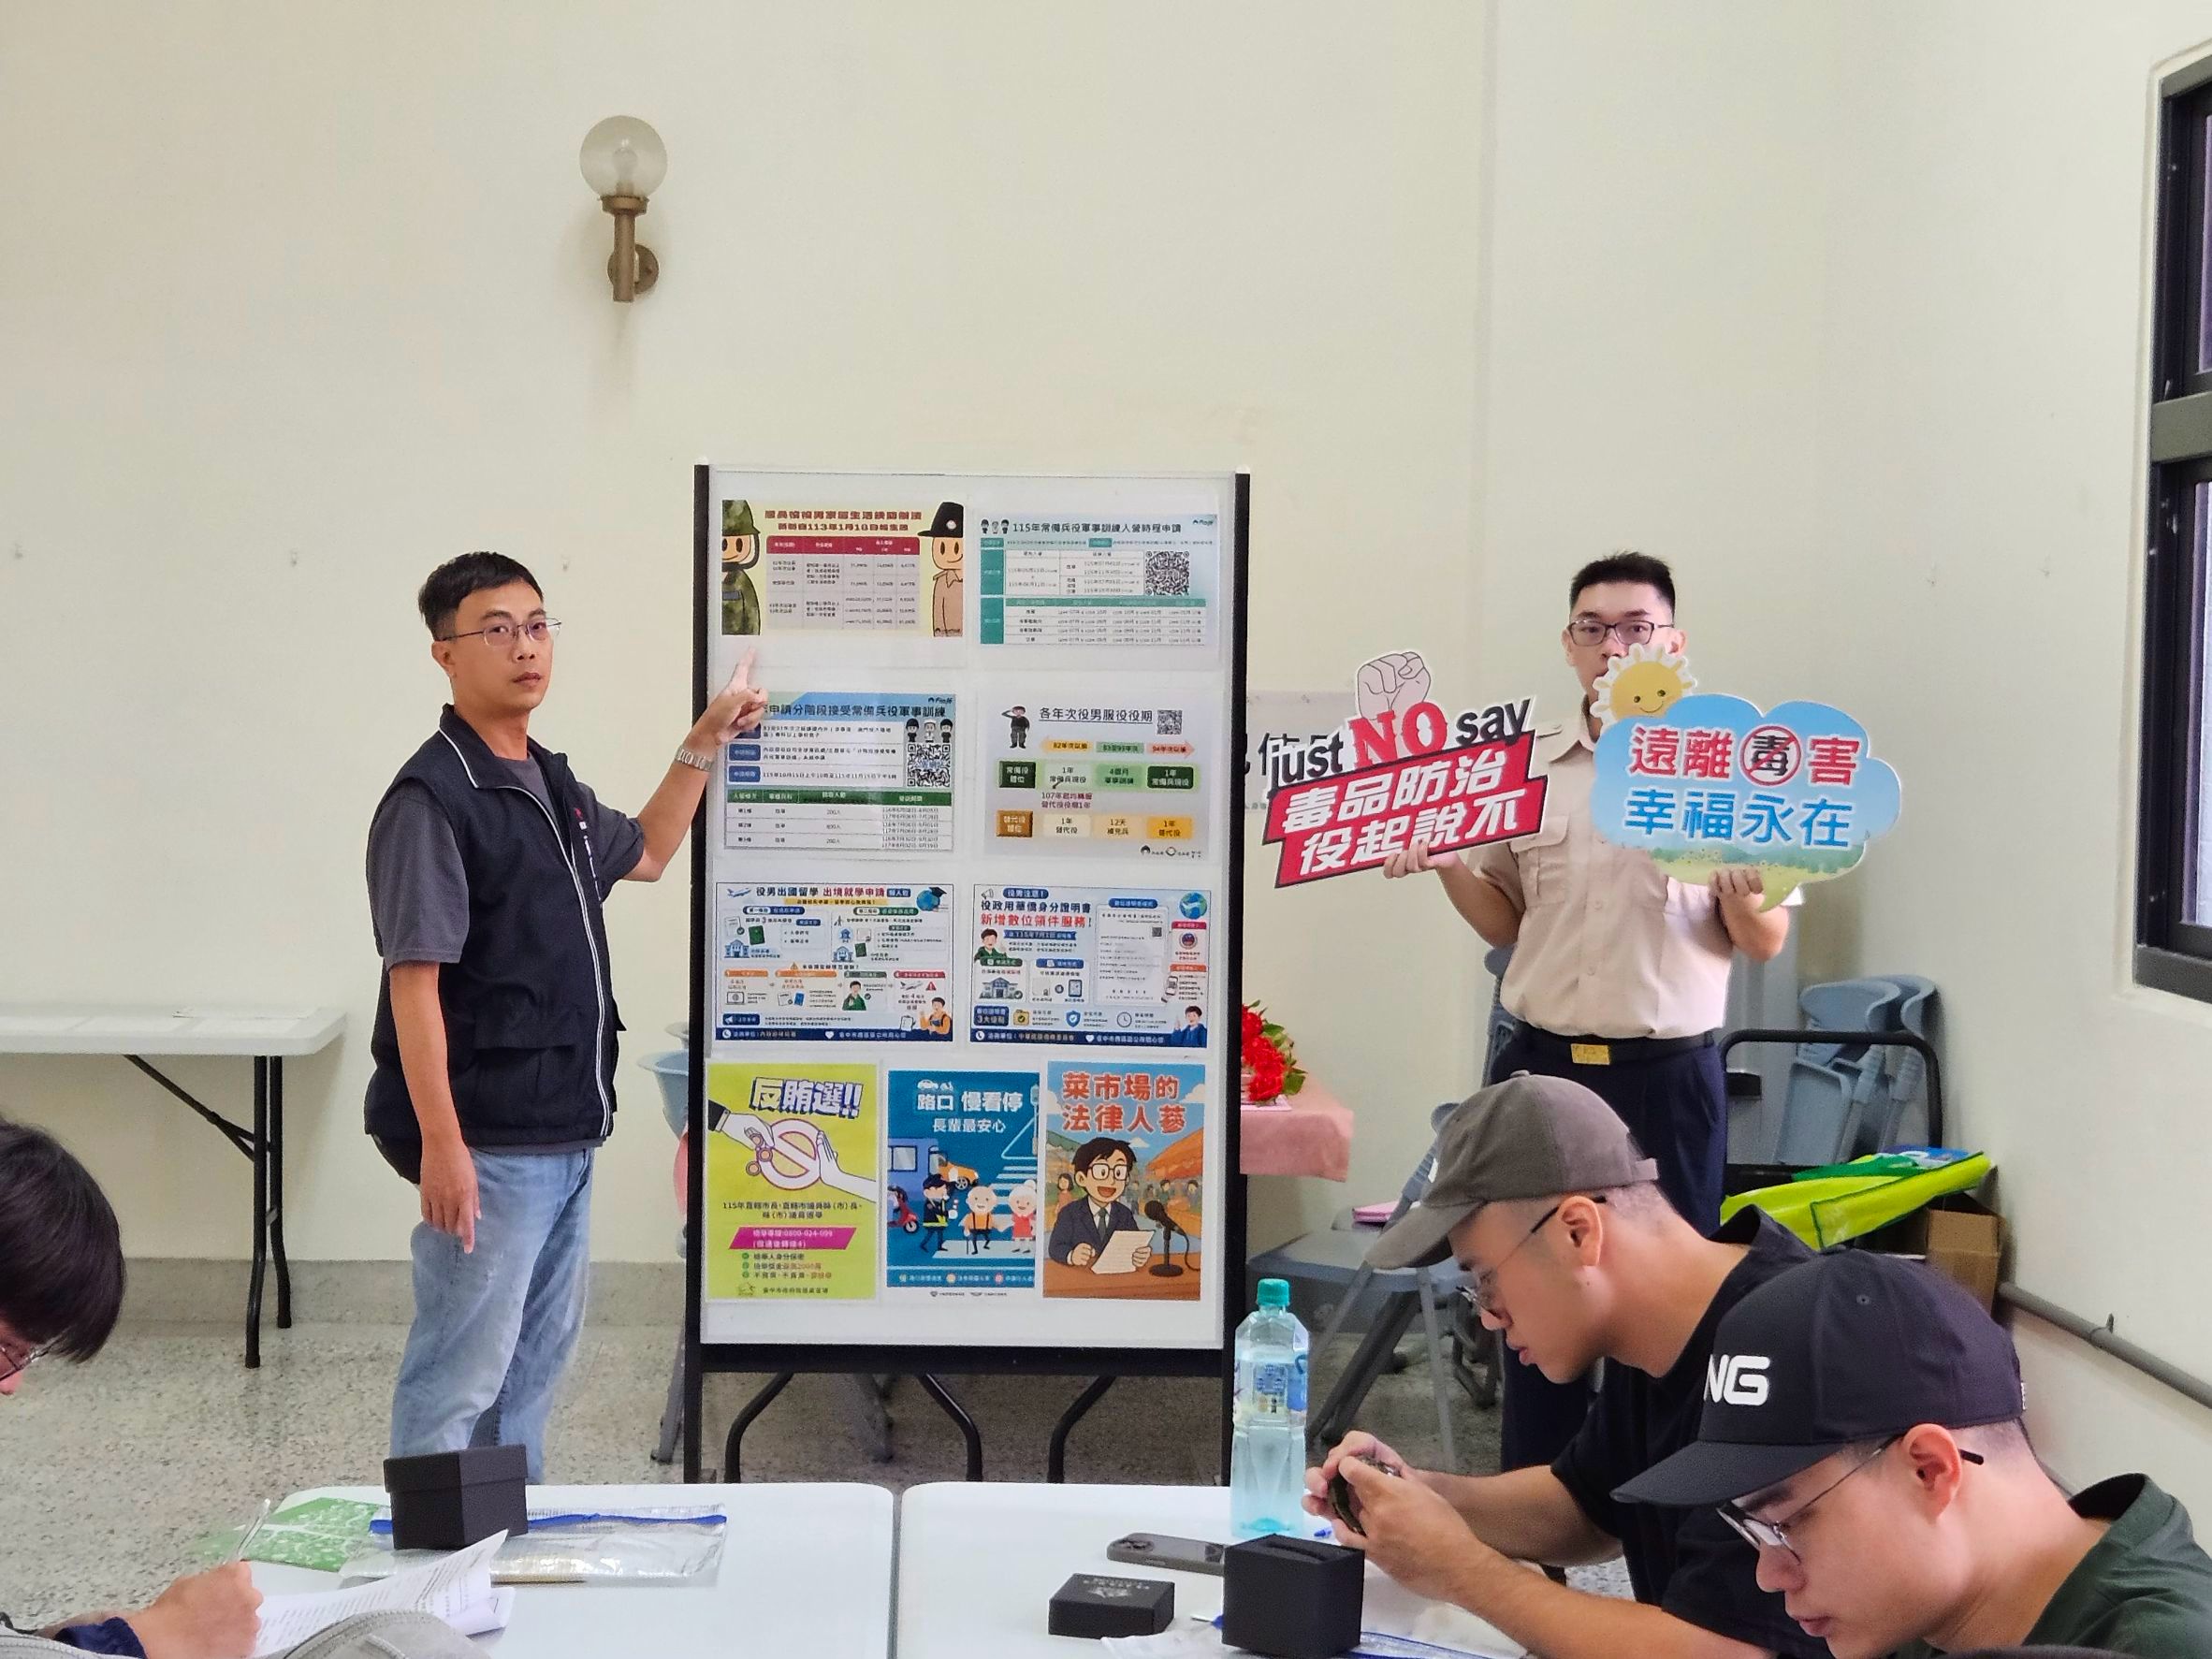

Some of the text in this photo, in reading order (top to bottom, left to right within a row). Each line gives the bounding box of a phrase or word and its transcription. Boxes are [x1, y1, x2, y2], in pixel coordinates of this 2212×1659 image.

[1040, 707, 1153, 721] 各年次役男服役役期
[1267, 733, 1345, 799] just
[1348, 702, 1448, 770] NO
[1456, 698, 1531, 749] say
[1629, 727, 1860, 786] 遠離毒害
[1062, 766, 1074, 775] 1年
[1283, 749, 1507, 834] 毒品防治
[1299, 789, 1527, 876] 役起說不
[1624, 789, 1853, 848] 幸福永在
[756, 886, 819, 897] 役男出國留學
[822, 887, 884, 897] 出境就學申請
[981, 900, 1091, 914] 役政用華僑身分證明書
[981, 913, 1092, 928] 新增數位領件服務！
[749, 1077, 864, 1119] 反賄選!!
[917, 1090, 1023, 1113] 路口 慢看停
[1063, 1071, 1179, 1102] 菜市場的
[932, 1117, 1006, 1134] 長輩最安心
[1062, 1104, 1186, 1135] 法律人蔘
